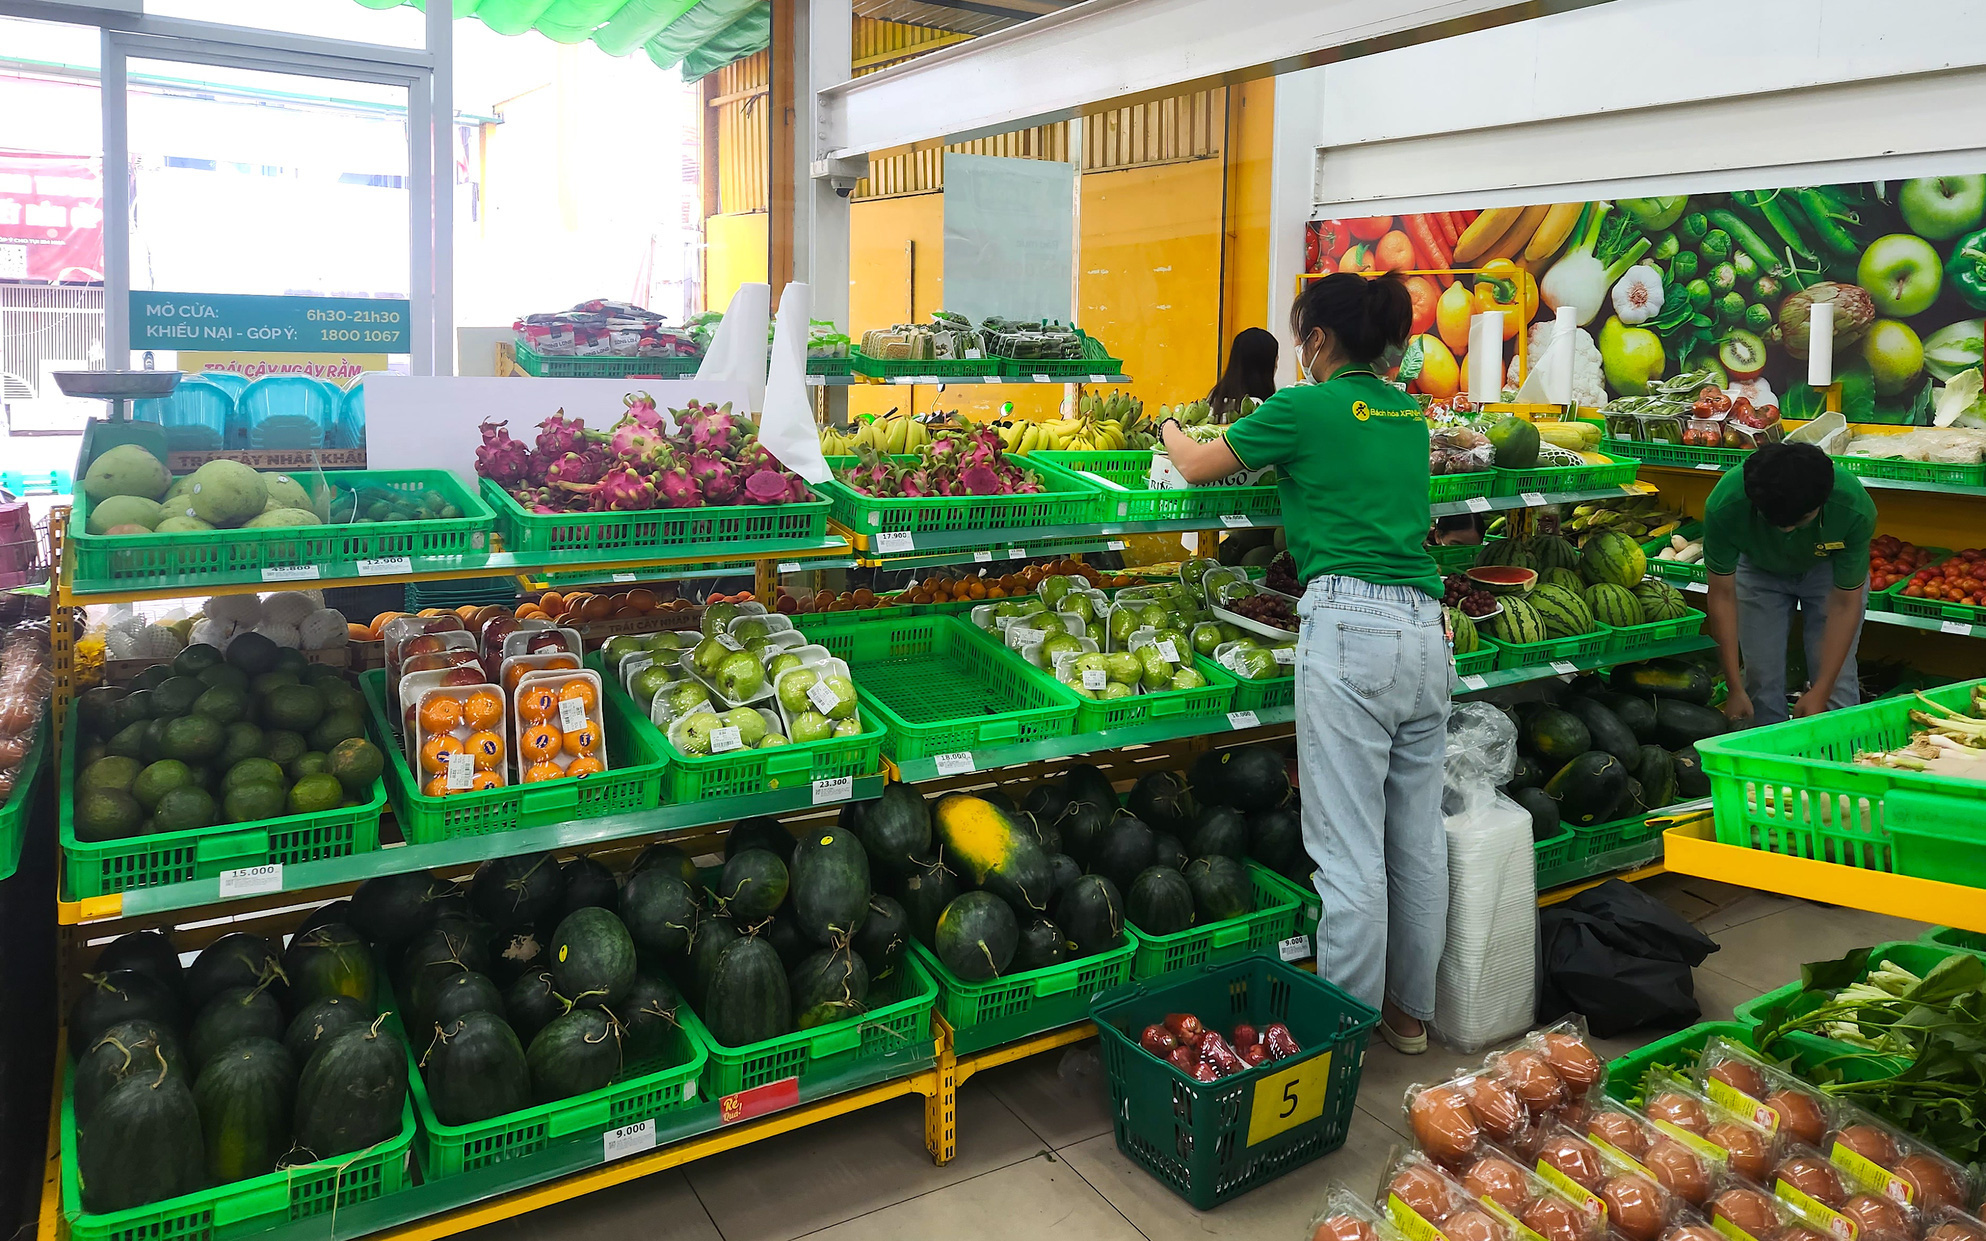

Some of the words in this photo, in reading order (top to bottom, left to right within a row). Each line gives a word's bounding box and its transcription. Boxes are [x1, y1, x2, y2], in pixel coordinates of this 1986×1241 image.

[146, 301, 176, 318] MỞ
[178, 302, 219, 319] CỬA:
[306, 309, 401, 324] 6h30-21h30
[146, 321, 200, 339] KHIẾU
[203, 326, 233, 342] NẠI
[246, 325, 282, 341] GÓP
[283, 325, 298, 341] Ý:
[320, 328, 361, 342] 1800
[363, 330, 401, 343] 1067
[882, 532, 908, 540] 17.900
[366, 557, 404, 565] 12.900
[940, 752, 967, 761] 18.000
[819, 778, 848, 789] 23.300
[232, 866, 275, 878] 15.000
[1285, 936, 1303, 947] 9.000
[1279, 1078, 1300, 1119] 5
[616, 1122, 646, 1139] 9.000
